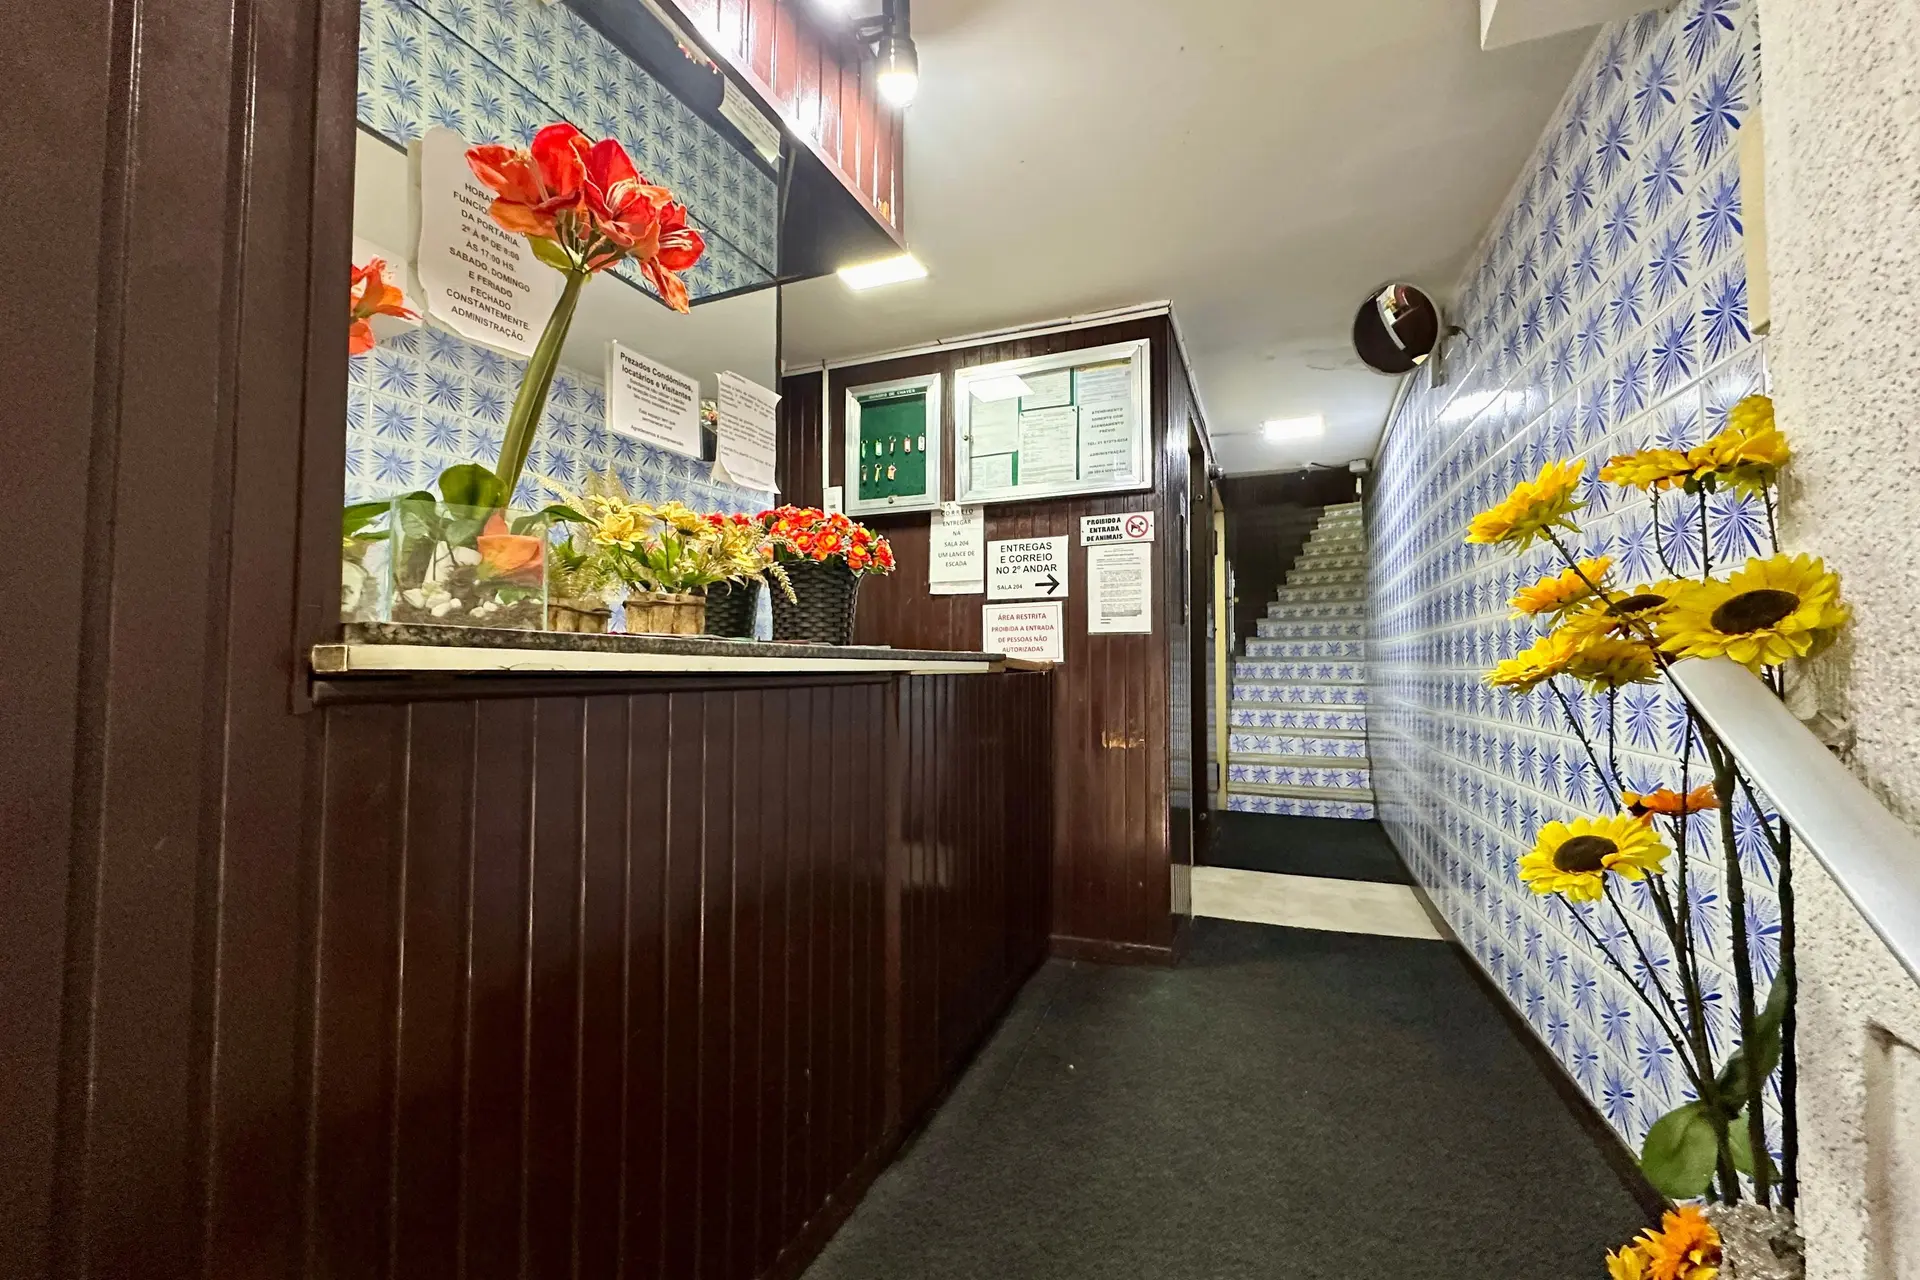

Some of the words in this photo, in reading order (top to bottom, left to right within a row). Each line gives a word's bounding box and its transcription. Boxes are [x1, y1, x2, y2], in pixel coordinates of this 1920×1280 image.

[461, 209, 475, 223] DA
[477, 217, 521, 248] PORTARIA.
[490, 240, 502, 252] DE
[481, 248, 501, 265] 17:00
[468, 270, 475, 280] E
[477, 274, 513, 298] FERIADO
[491, 267, 530, 293] DOMINGO
[470, 286, 511, 311] FECHADO
[446, 288, 531, 331] CONSTANTEMENTE.
[451, 305, 526, 343] ADMINISTRAÇÃO.
[620, 352, 651, 373] Prezados
[652, 367, 694, 393] Condôminos,
[621, 364, 655, 386] locatários
[660, 382, 692, 402] Visitantes
[940, 508, 974, 517] CORREIO
[942, 519, 972, 527] ENTREGAR
[1086, 517, 1116, 526] PROIBIDO
[1089, 525, 1120, 534] ENTRADA
[1095, 533, 1123, 541] ANIMAIS
[1000, 541, 1053, 553] ENTREGAS
[1008, 552, 1053, 563] CORREIO
[996, 566, 1010, 575] NO
[1022, 563, 1057, 573] ANDAR
[998, 613, 1015, 621] ÁREA
[1033, 634, 1048, 642] NÃO
